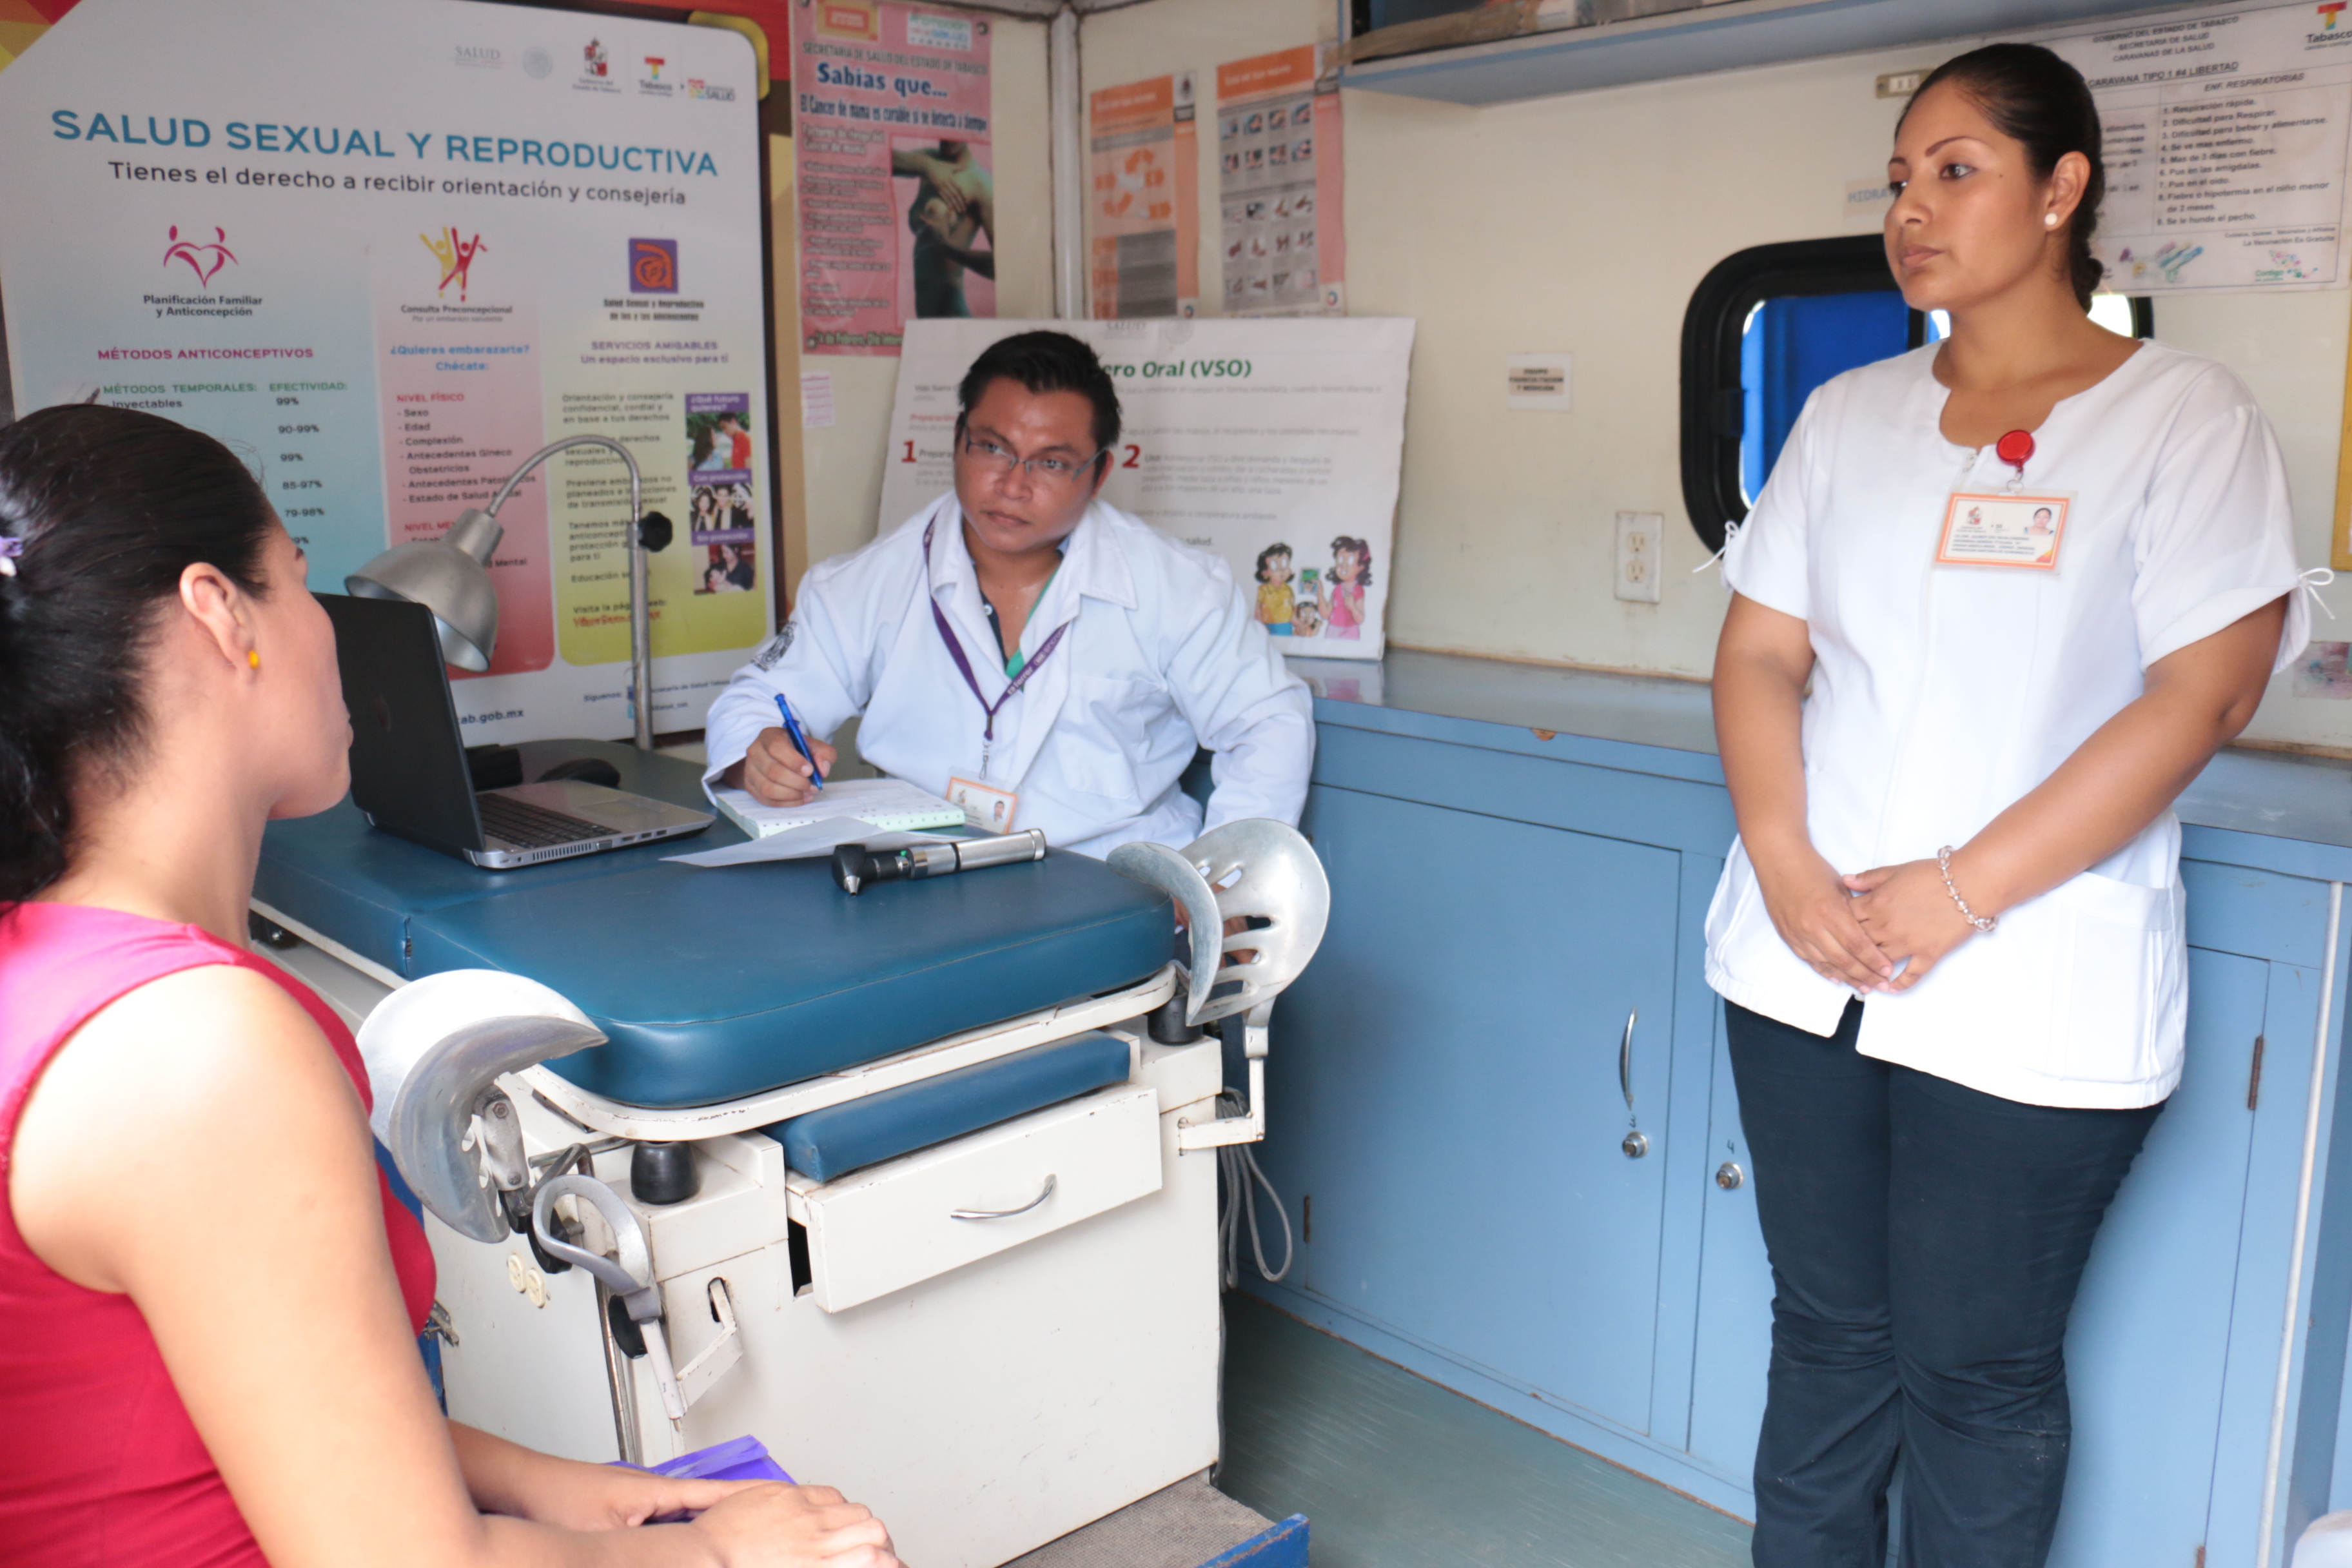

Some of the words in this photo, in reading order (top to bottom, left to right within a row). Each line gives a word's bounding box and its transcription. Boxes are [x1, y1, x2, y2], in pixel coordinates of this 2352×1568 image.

[2093, 31, 2134, 43] GOBIERNO
[2135, 29, 2149, 37] DEL
[2153, 26, 2184, 35] ESTADO
[2200, 16, 2239, 26] TABASCO
[2119, 39, 2167, 50] SECRETARIA
[2183, 32, 2210, 42] SALUD
[2306, 31, 2352, 43] Tabasco
[456, 46, 500, 60] SALUD
[2113, 51, 2160, 62] CARAVANAS
[2188, 43, 2215, 52] SALUD
[816, 61, 886, 90] Sabias
[894, 77, 948, 98] que...
[2089, 74, 2139, 87] CARAVANA
[2142, 70, 2165, 81] TIPO
[2190, 61, 2239, 75] LIBERTAD
[639, 79, 672, 91] Tabasco
[2226, 72, 2305, 89] RESPIRATORIAS
[2171, 116, 2211, 126] Dificultad
[2214, 114, 2233, 123] para
[2236, 109, 2277, 120] Respirar.
[2171, 128, 2211, 139] Dificultad
[2213, 127, 2233, 136] para
[2235, 123, 2262, 132] beber
[2271, 117, 2328, 129] alimentarse.
[51, 110, 211, 148] SALUD
[225, 122, 395, 157] SEXUAL
[406, 132, 432, 160] Y
[446, 134, 718, 177] REPRODUCTIVA
[108, 161, 197, 183] Tienes
[206, 166, 227, 185] el
[236, 168, 335, 189] derecho
[343, 175, 357, 190] a
[364, 172, 435, 193] recibir
[442, 177, 562, 199] orientación
[568, 186, 580, 202] y
[586, 183, 686, 206] consejería
[2168, 191, 2194, 201] Fiebre
[2204, 187, 2250, 199] hipotermia
[2276, 184, 2297, 192] niño
[2298, 181, 2329, 191] menor
[2189, 215, 2215, 224] hunde
[2228, 212, 2257, 222] pecho.
[143, 295, 215, 306] Planificación
[219, 295, 262, 306] Familiar
[156, 308, 162, 318] y
[166, 305, 253, 317] Anticoncepción
[400, 305, 440, 313] Consulta
[442, 306, 513, 315] Preconcepcional
[390, 345, 445, 355] ¿Quieres
[449, 344, 530, 355] embarazarte?
[591, 341, 651, 350] SERVICIOS
[655, 340, 718, 350] AMIGABLES
[98, 346, 173, 360] MÉTODOS
[177, 348, 314, 359] ANTICONCEPTIVOS
[581, 355, 596, 364] Un
[599, 355, 640, 365] espacio
[694, 356, 718, 365] para
[1103, 364, 1136, 378] ero
[1142, 360, 1185, 378] Oral
[1190, 359, 1252, 378] (VSO)
[103, 382, 166, 394] MÉTODOS
[172, 383, 258, 393] TEMPORALES:
[269, 382, 348, 392] EFECTIVIDAD:
[276, 397, 299, 406] 99%
[397, 394, 428, 403] NIVEL
[430, 392, 465, 402] FÍSICO
[562, 393, 616, 403] Orientación
[627, 392, 673, 402] consejería
[404, 409, 429, 417] Sexo
[624, 403, 655, 412] cordial
[657, 404, 663, 412] y
[577, 415, 600, 424] base
[627, 414, 670, 422] derechos
[278, 425, 319, 434] 90-99%
[404, 423, 431, 431] Edad
[405, 436, 463, 446] Complexión
[407, 450, 476, 460] Antecedentes
[901, 439, 917, 463] 1
[1121, 444, 1141, 469] 2
[280, 453, 303, 462] 99%
[282, 481, 322, 490] 85-97%
[409, 478, 478, 489] Antecedentes
[284, 508, 324, 517] 79-98%
[404, 523, 434, 532] NIVEL
[495, 557, 527, 567] Mental
